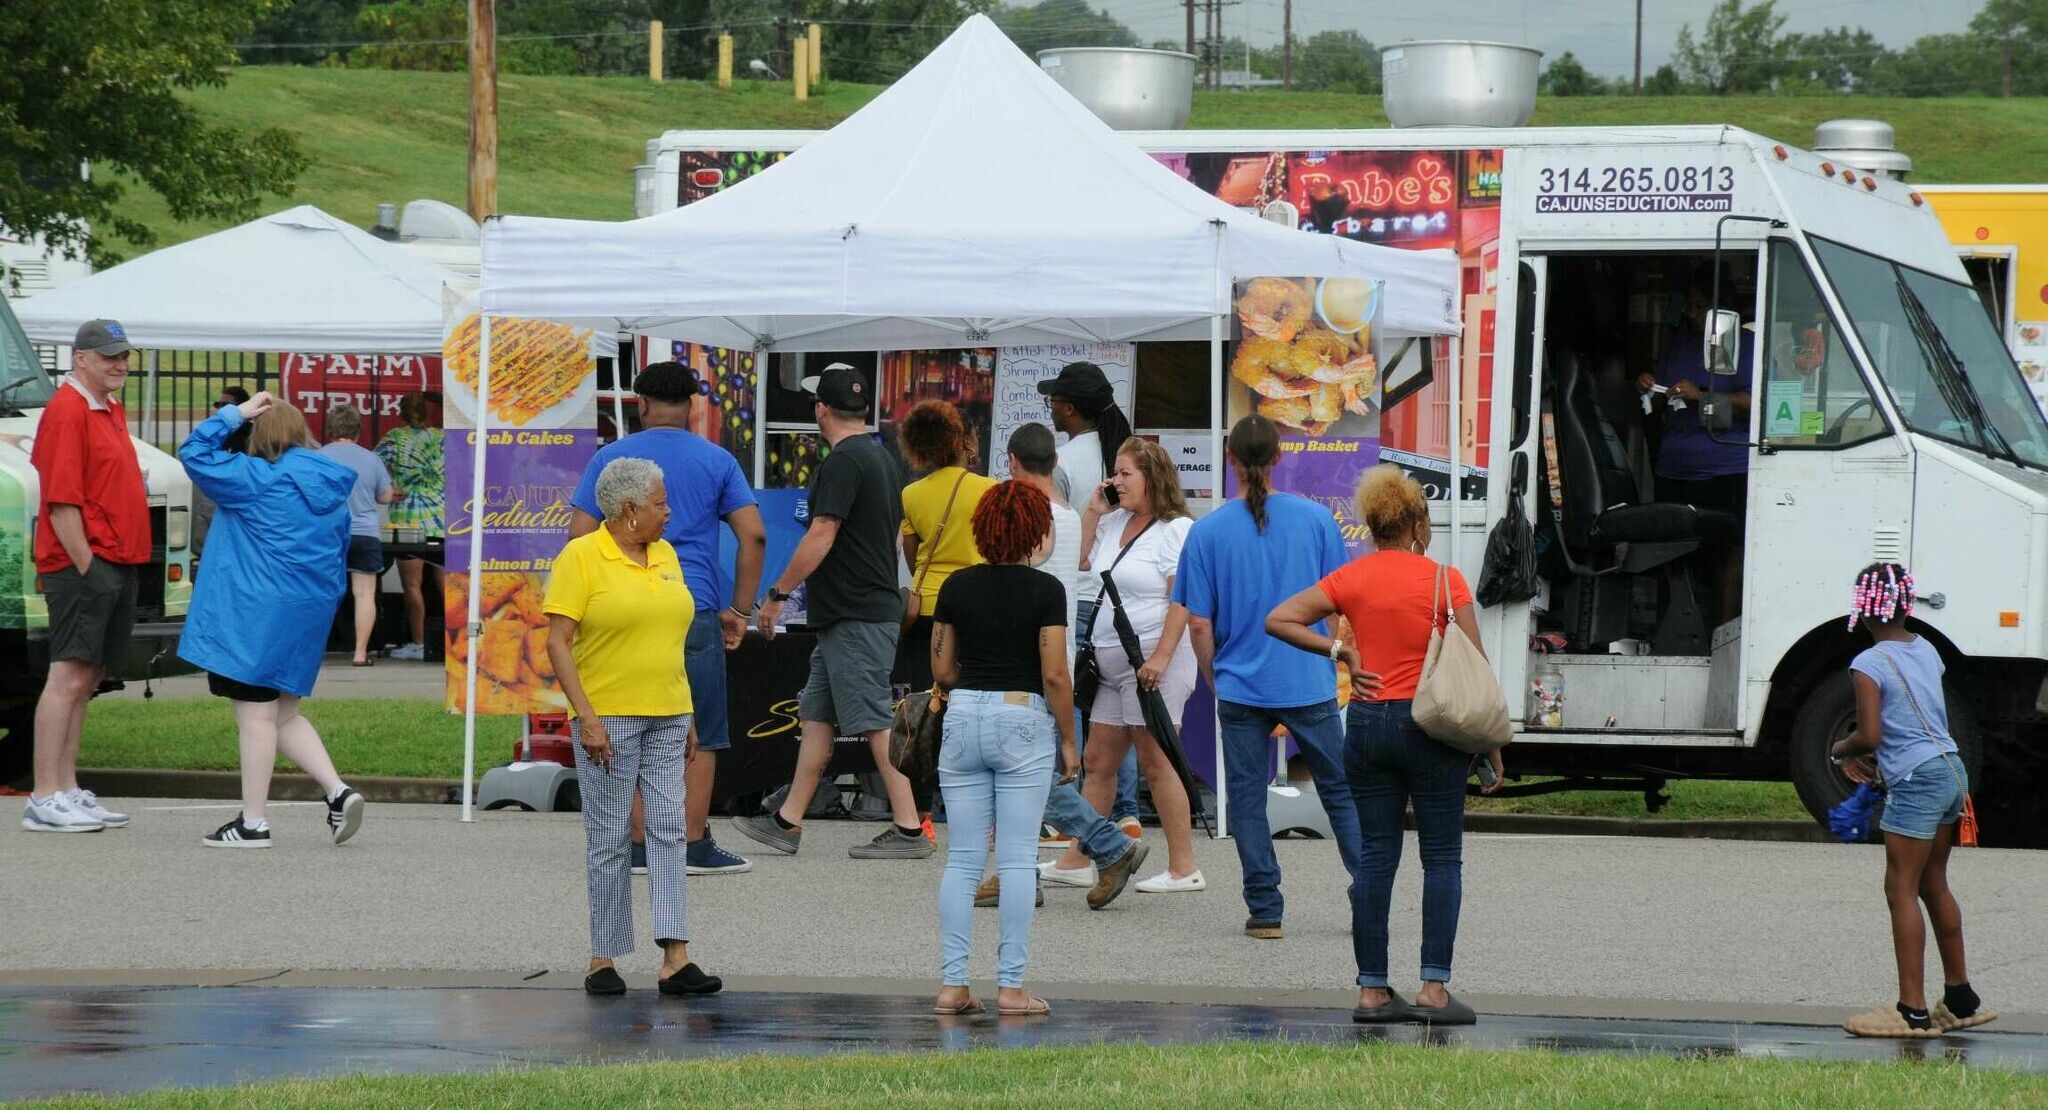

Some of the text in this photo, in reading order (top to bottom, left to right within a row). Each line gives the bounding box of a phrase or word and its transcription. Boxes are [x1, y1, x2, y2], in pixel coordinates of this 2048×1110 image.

[1539, 166, 1735, 193] 314.265.0813
[1537, 195, 1730, 212] CAJUNSEDUCTION.com
[1050, 344, 1089, 357] Basket
[298, 354, 414, 377] FARM
[1002, 363, 1040, 380] Shrimp
[1001, 385, 1041, 403] Combo
[1002, 406, 1041, 421] Salmon
[1775, 401, 1793, 421] A
[516, 431, 575, 446] Cakes
[1305, 440, 1360, 453] Basket
[1183, 446, 1197, 455] NO
